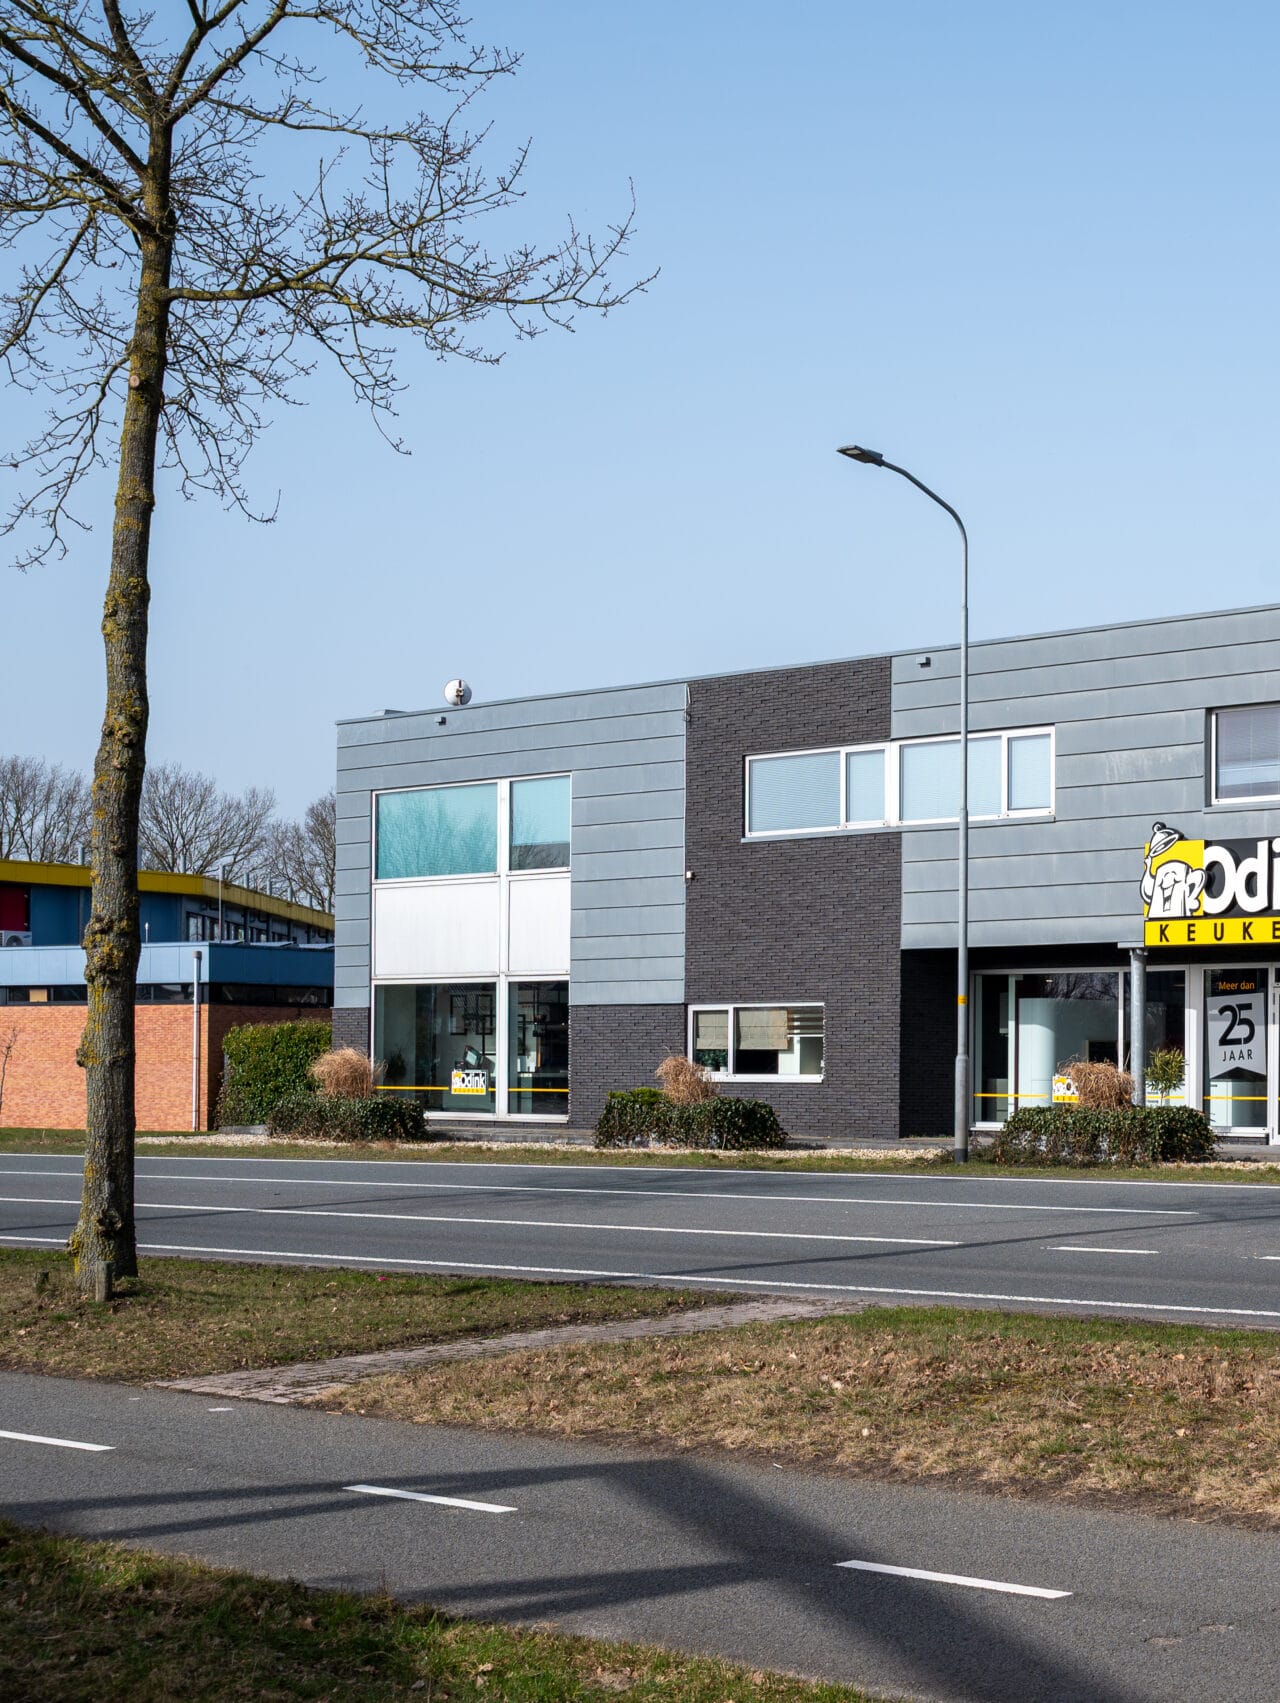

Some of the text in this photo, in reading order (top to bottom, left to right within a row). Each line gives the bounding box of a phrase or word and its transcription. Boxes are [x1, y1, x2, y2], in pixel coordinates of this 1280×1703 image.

[1218, 980, 1255, 991] Meer dan
[1218, 1002, 1255, 1046] 25
[1222, 1049, 1253, 1062] JAAR
[461, 1072, 485, 1088] Odink
